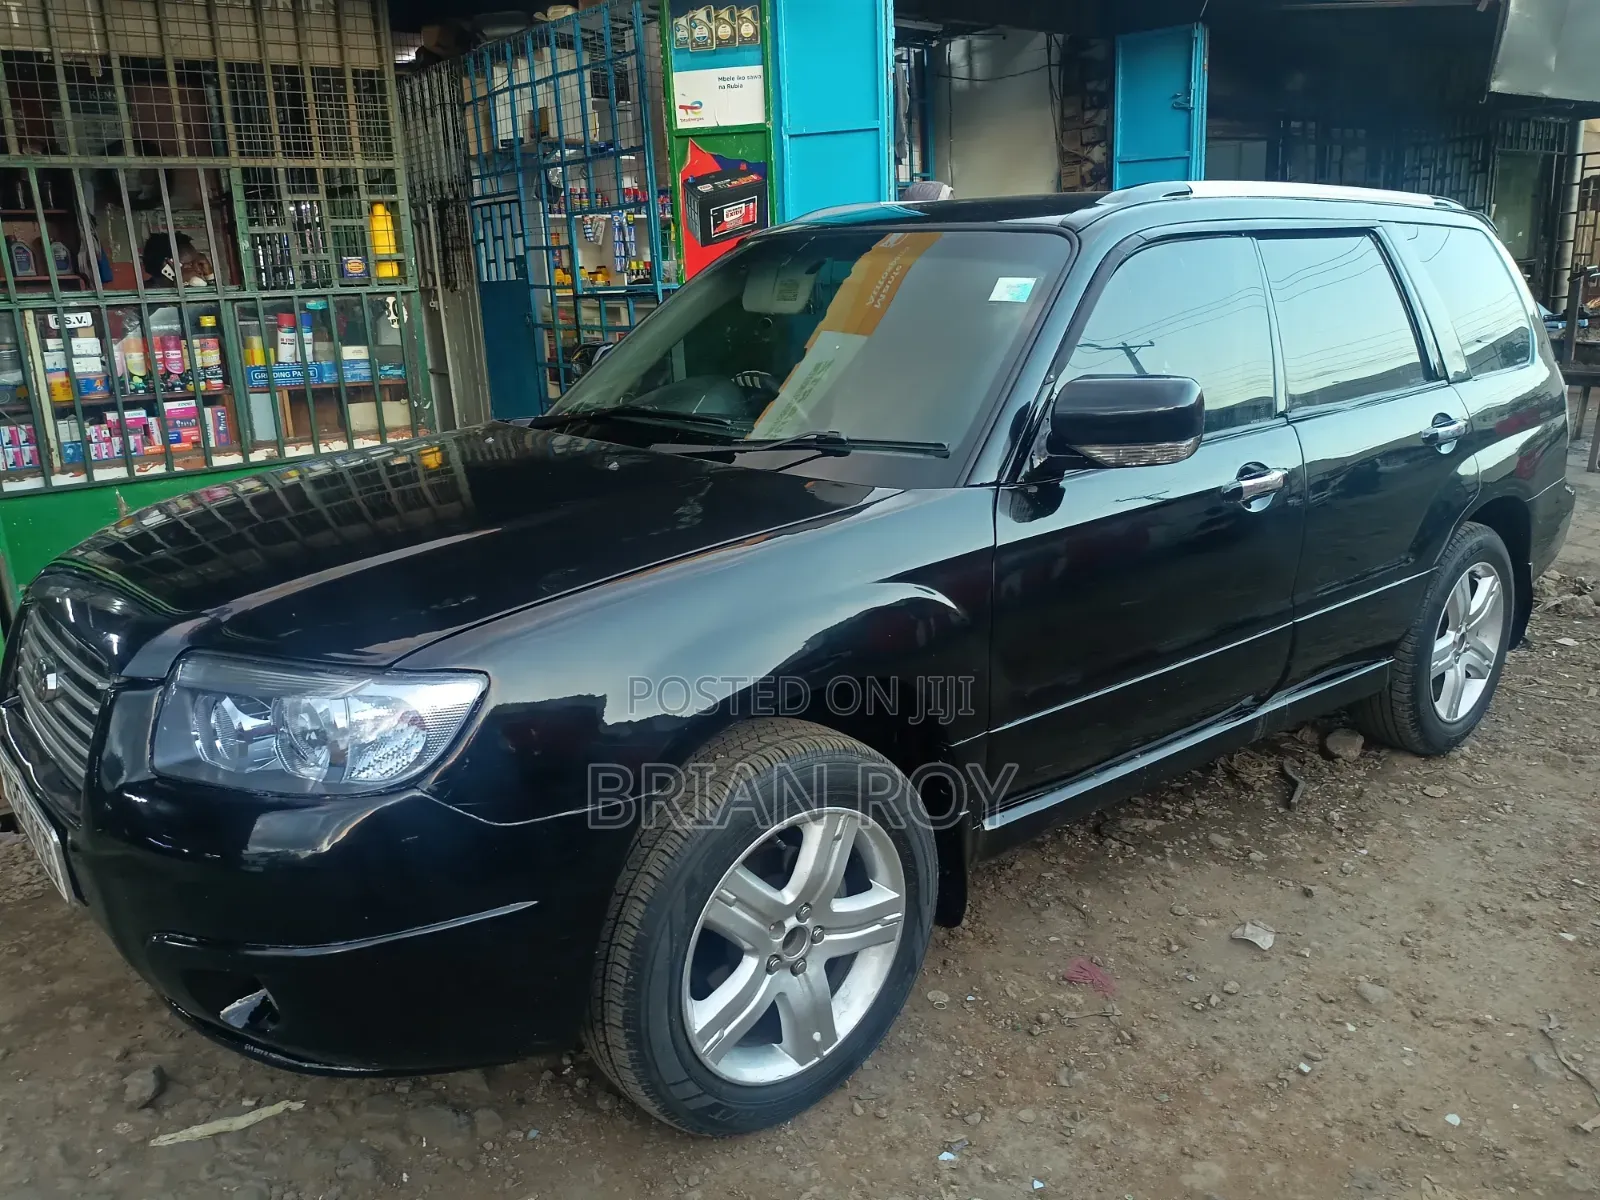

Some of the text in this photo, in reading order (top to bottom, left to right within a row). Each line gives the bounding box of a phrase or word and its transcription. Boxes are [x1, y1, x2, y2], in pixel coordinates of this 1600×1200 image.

[725, 208, 743, 219] EXIDE
[54, 315, 87, 326] PS.V.
[254, 371, 291, 380] GRIDING
